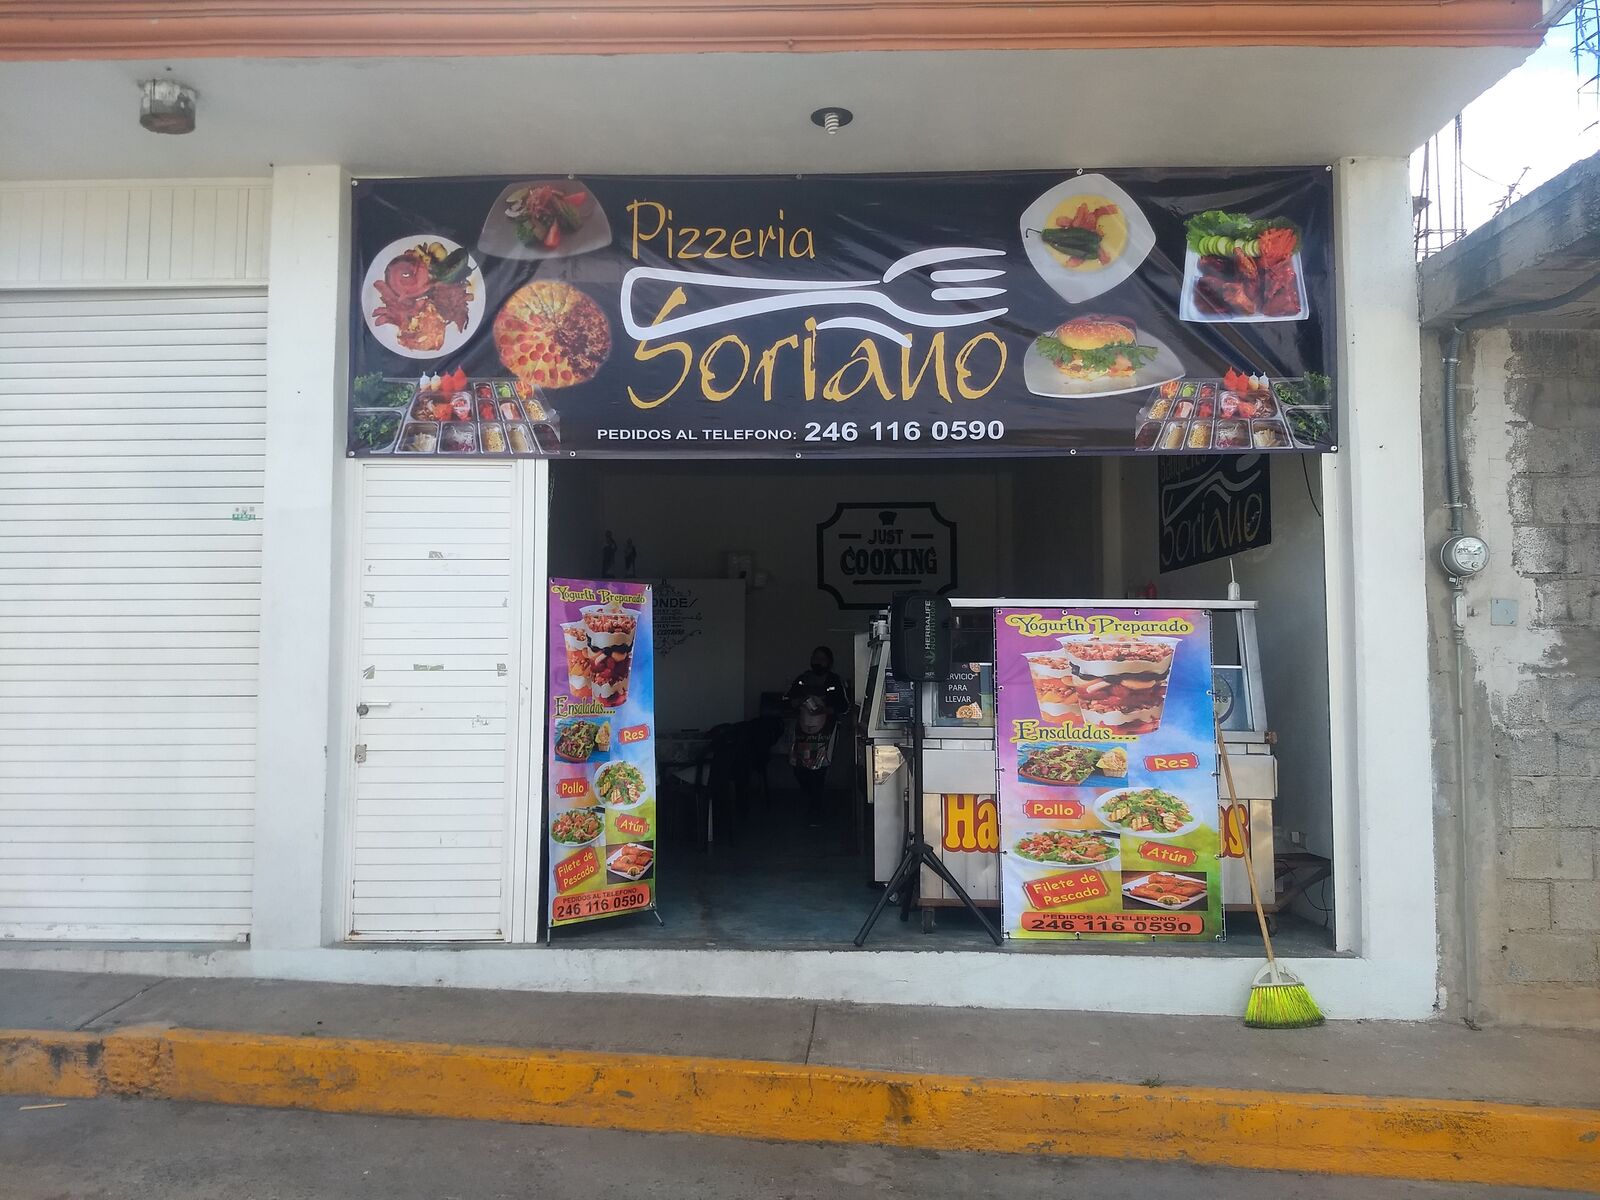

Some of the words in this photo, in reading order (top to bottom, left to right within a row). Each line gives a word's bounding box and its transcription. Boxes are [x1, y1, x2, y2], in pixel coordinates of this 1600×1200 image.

[626, 198, 816, 260] Pizzeria
[626, 286, 1008, 410] Soriano
[597, 429, 672, 441] PEDIDOS
[675, 429, 699, 441] AL
[702, 429, 797, 441] TELEFONO:
[804, 421, 858, 442] 246
[869, 421, 921, 442] 116
[931, 420, 1005, 441] 0590
[867, 529, 904, 545] JUST
[840, 546, 937, 575] COOKING
[552, 586, 596, 601] Yogurth
[597, 589, 646, 604] Preparado
[1010, 615, 1085, 634] Yogurth
[1092, 617, 1189, 634] Preparado
[949, 673, 974, 681] RVICIO
[948, 684, 968, 692] PARA
[623, 729, 644, 741] Res
[1154, 757, 1190, 770] Res
[561, 783, 584, 795] Pollo
[1032, 803, 1074, 816] Pollo
[620, 817, 645, 833] Atún
[557, 861, 581, 878] Filete
[583, 852, 594, 862] de
[1147, 847, 1188, 865] Atún
[563, 866, 595, 888] Pescado
[1033, 877, 1076, 894] Filete
[1080, 873, 1098, 885] de
[562, 895, 591, 904] PEDIDOS
[1043, 886, 1100, 905] Pescado
[557, 903, 581, 918] 246
[586, 899, 609, 913] 116
[613, 893, 644, 909] 0590
[1031, 919, 1075, 930] 246
[1083, 920, 1125, 931] 116
[1133, 921, 1192, 932] 0590
